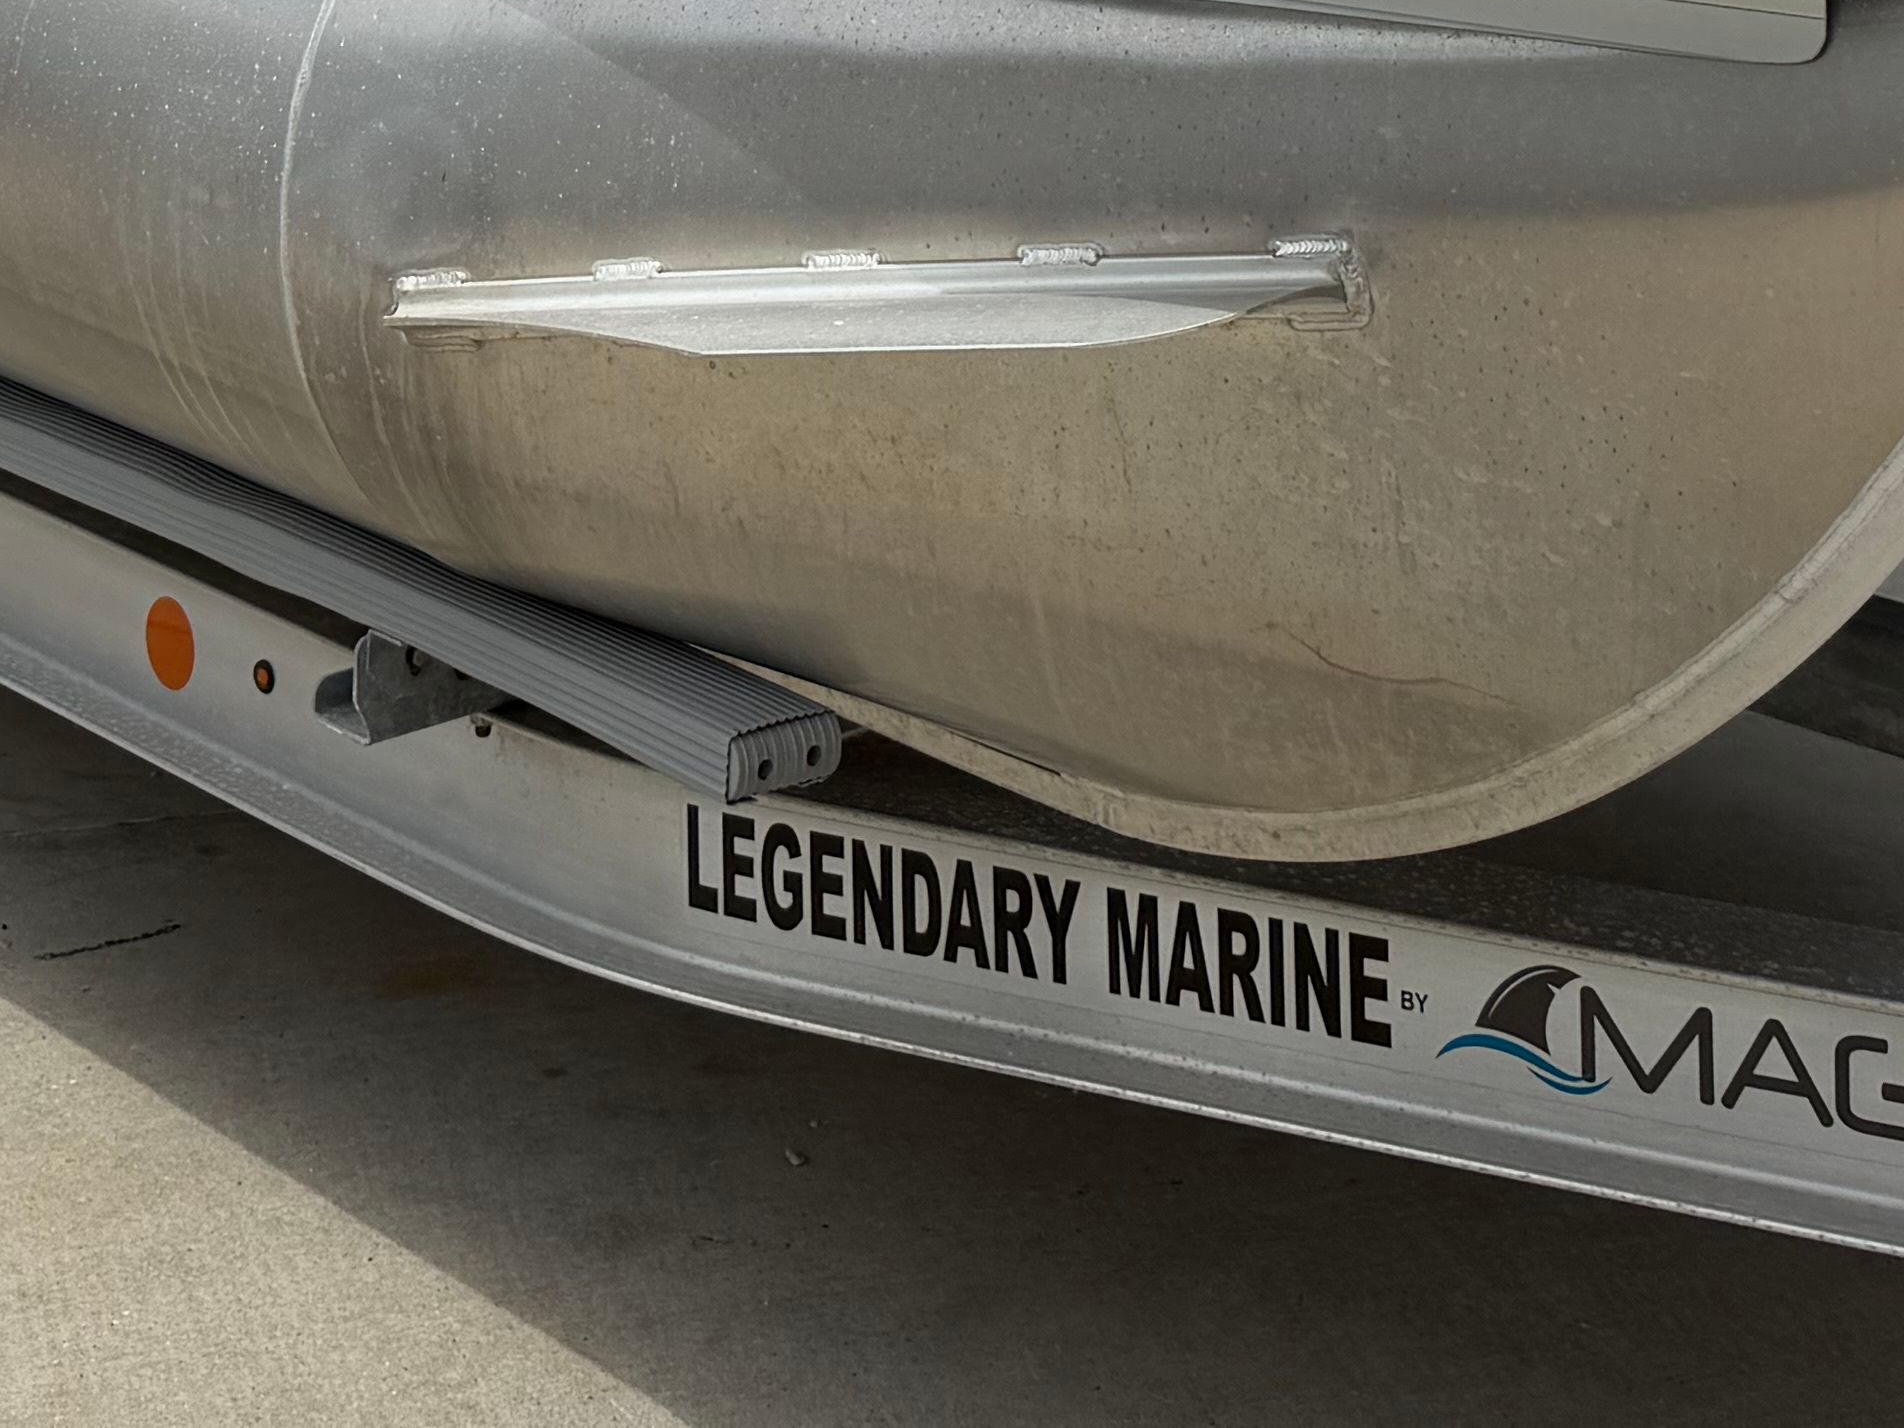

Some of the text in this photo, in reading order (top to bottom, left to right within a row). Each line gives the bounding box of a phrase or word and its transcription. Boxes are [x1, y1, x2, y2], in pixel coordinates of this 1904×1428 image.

[688, 803, 1082, 984] LEGENDARY
[1105, 887, 1393, 1047] MARINE
[1400, 990, 1428, 1016] BY
